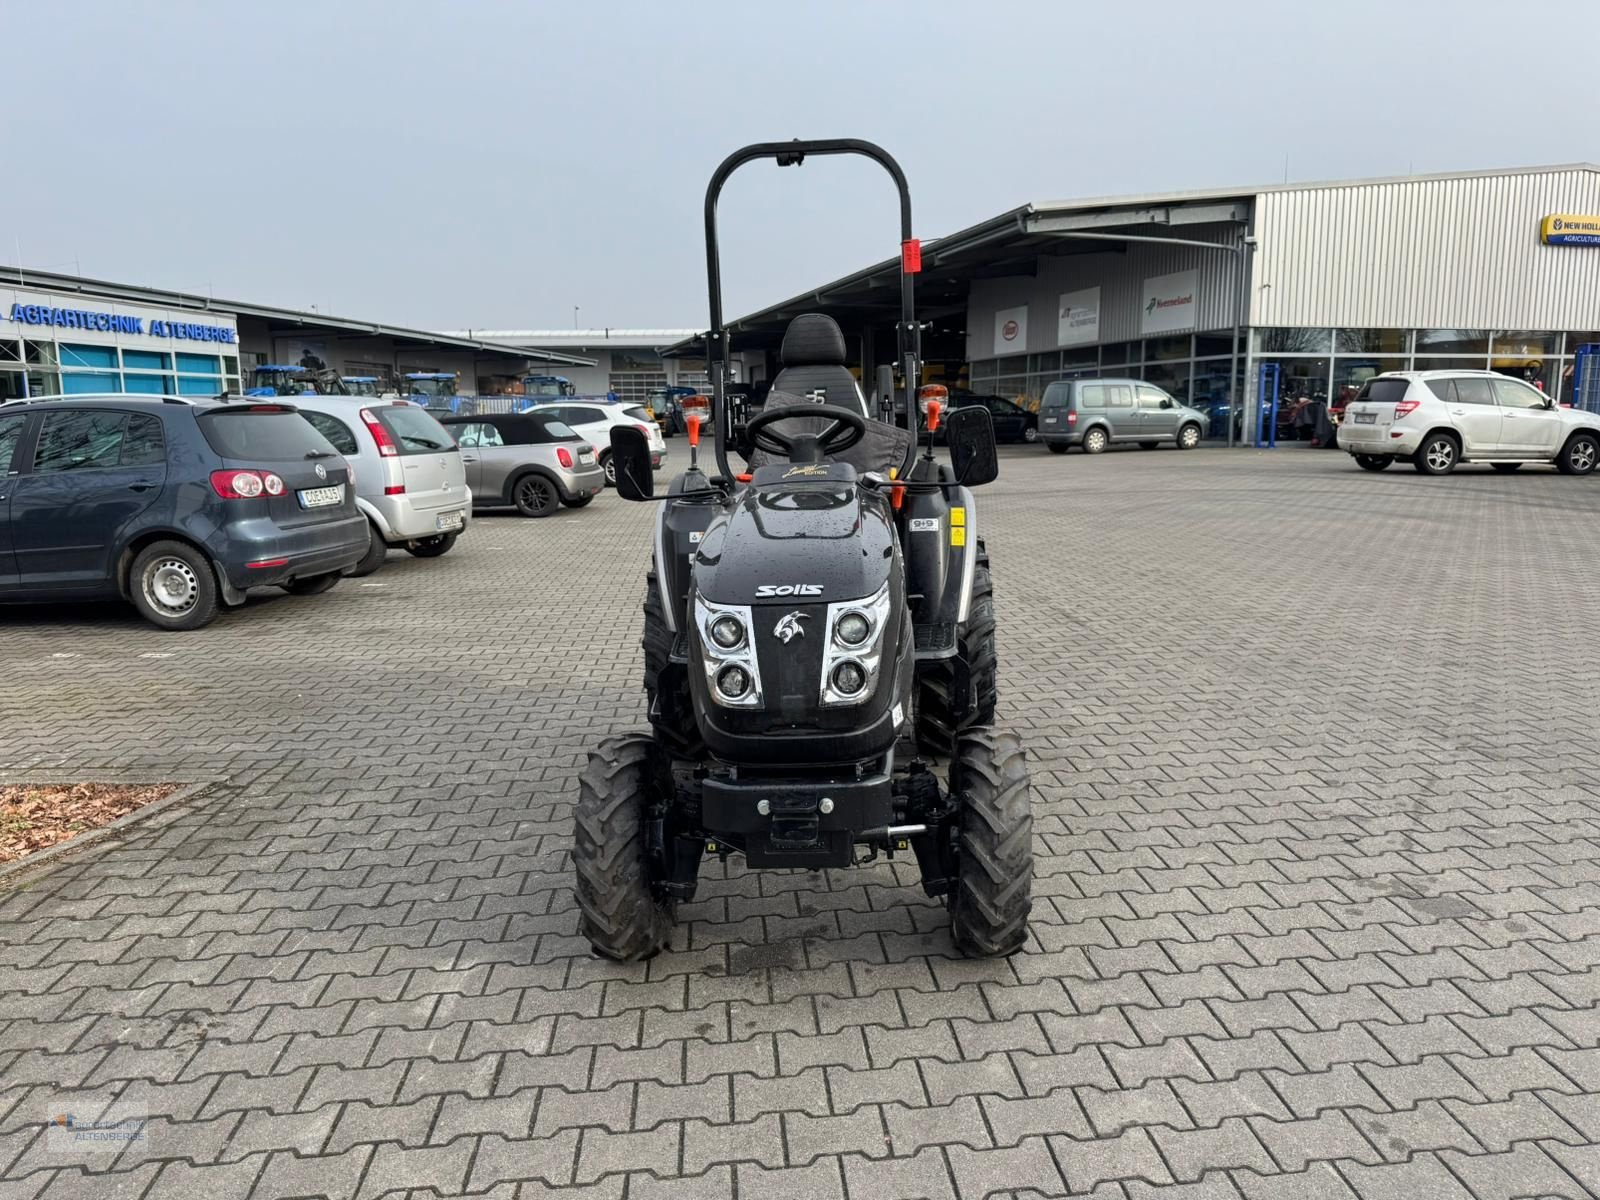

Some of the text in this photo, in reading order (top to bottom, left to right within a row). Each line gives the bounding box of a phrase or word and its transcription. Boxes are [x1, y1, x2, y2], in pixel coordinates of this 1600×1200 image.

[1564, 222, 1600, 231] NEW HOLL
[10, 303, 237, 344] AGRARTECHNIK ALTENBERGE
